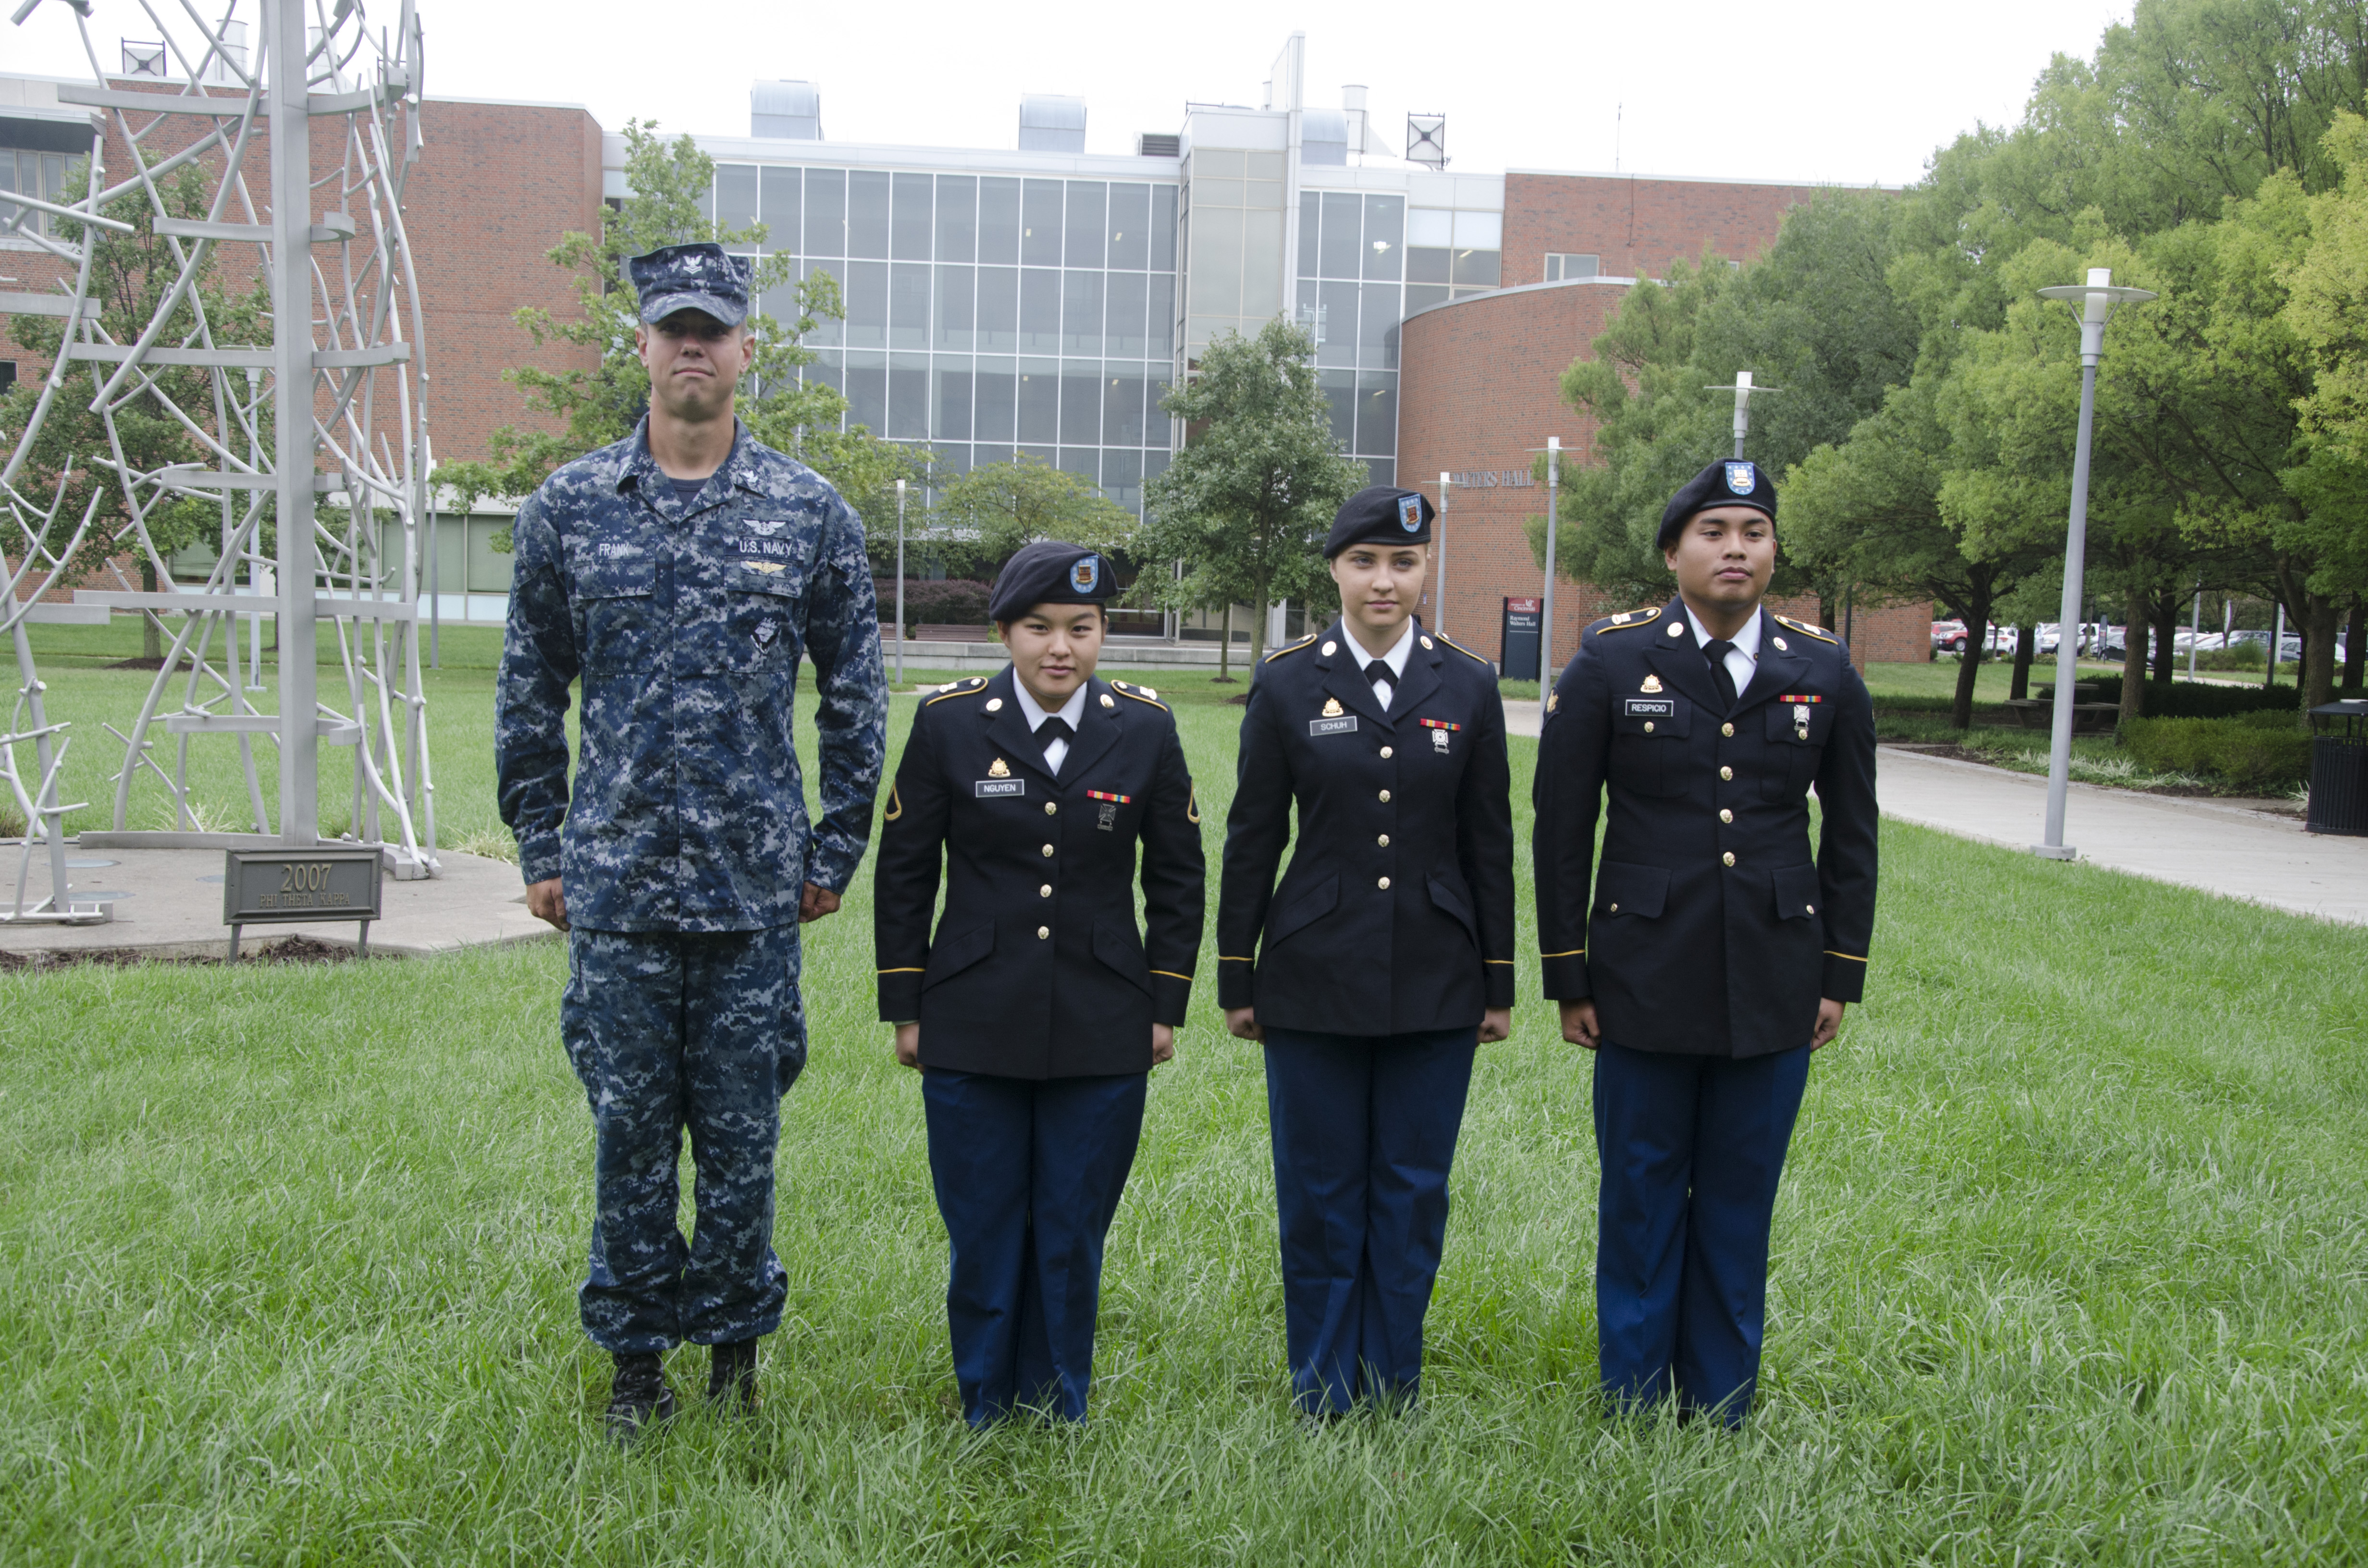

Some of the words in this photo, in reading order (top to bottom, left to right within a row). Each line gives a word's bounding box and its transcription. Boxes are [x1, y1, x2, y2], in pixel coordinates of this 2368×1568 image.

[1502, 470, 1534, 487] HALL
[599, 543, 629, 556] FRANK
[739, 540, 760, 553] U.S.
[763, 542, 792, 556] NAVY
[1631, 703, 1666, 712] RESPICIO
[1320, 721, 1347, 731] SCHUH
[984, 784, 1016, 793] NGUYEN
[280, 863, 333, 892] 2007
[259, 894, 278, 907] PHI
[283, 894, 313, 907] THETA
[320, 893, 350, 906] KAPPA
